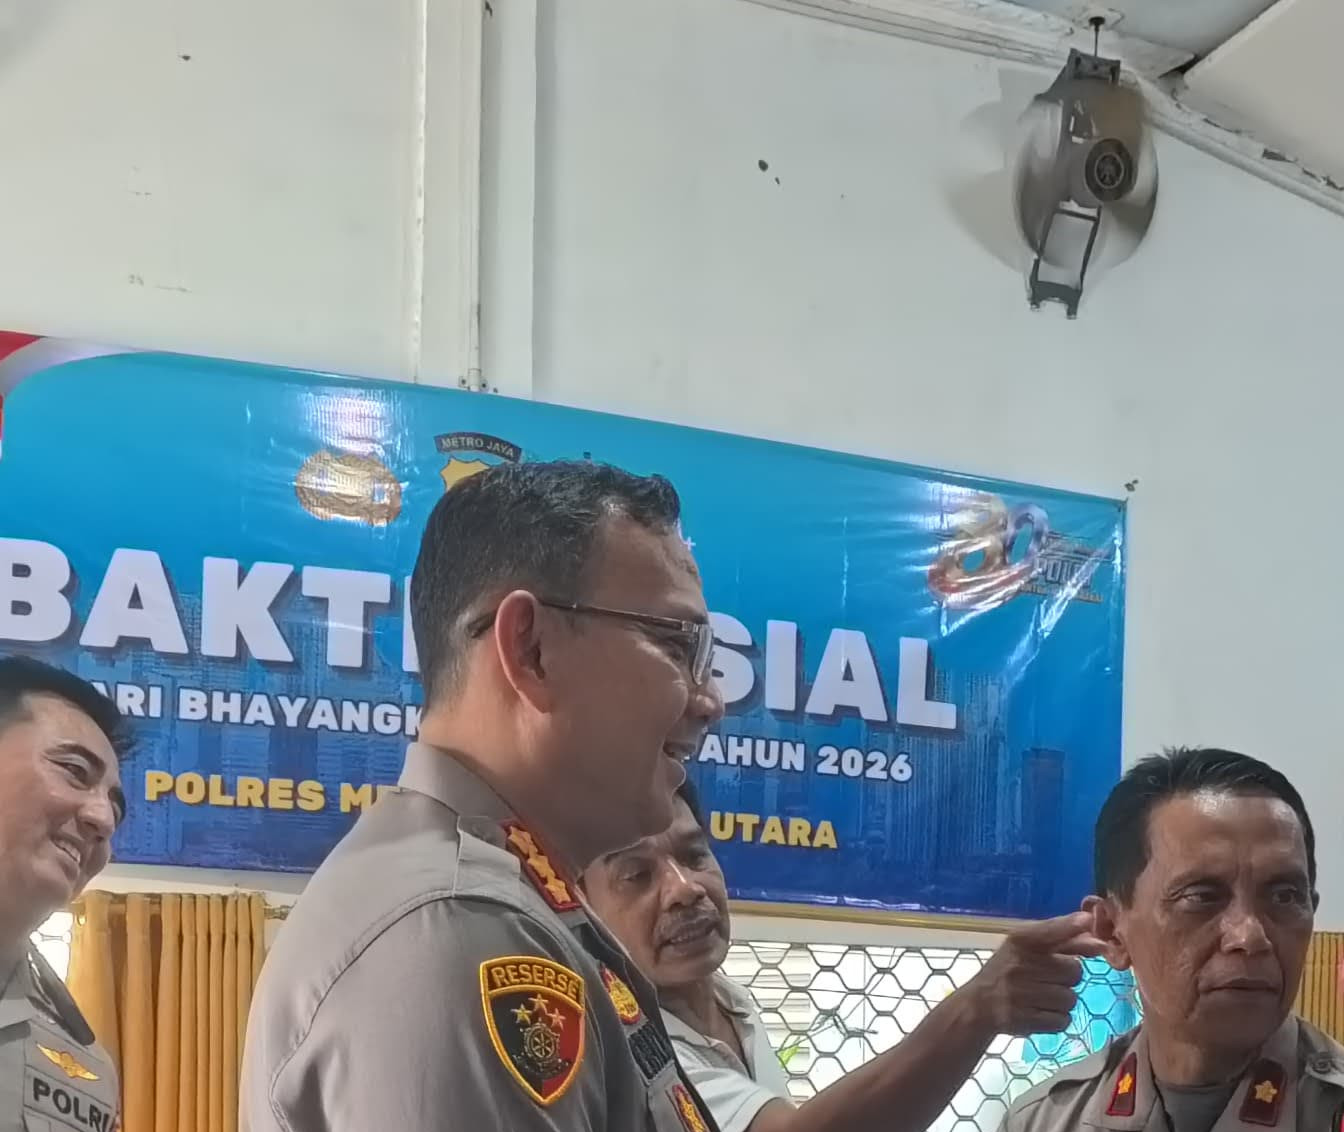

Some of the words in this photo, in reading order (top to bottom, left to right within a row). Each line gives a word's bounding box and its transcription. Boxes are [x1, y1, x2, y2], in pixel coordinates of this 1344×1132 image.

[441, 436, 484, 449] METRO
[487, 442, 514, 458] JAYA
[706, 611, 956, 730] SIAL
[92, 681, 162, 718] RI
[178, 685, 421, 737] BHAYANGK
[697, 733, 806, 772] AHUN
[815, 745, 914, 783] 2026
[145, 769, 325, 813] POLRES
[709, 810, 838, 849] UTARA
[490, 963, 578, 999] RESERSE
